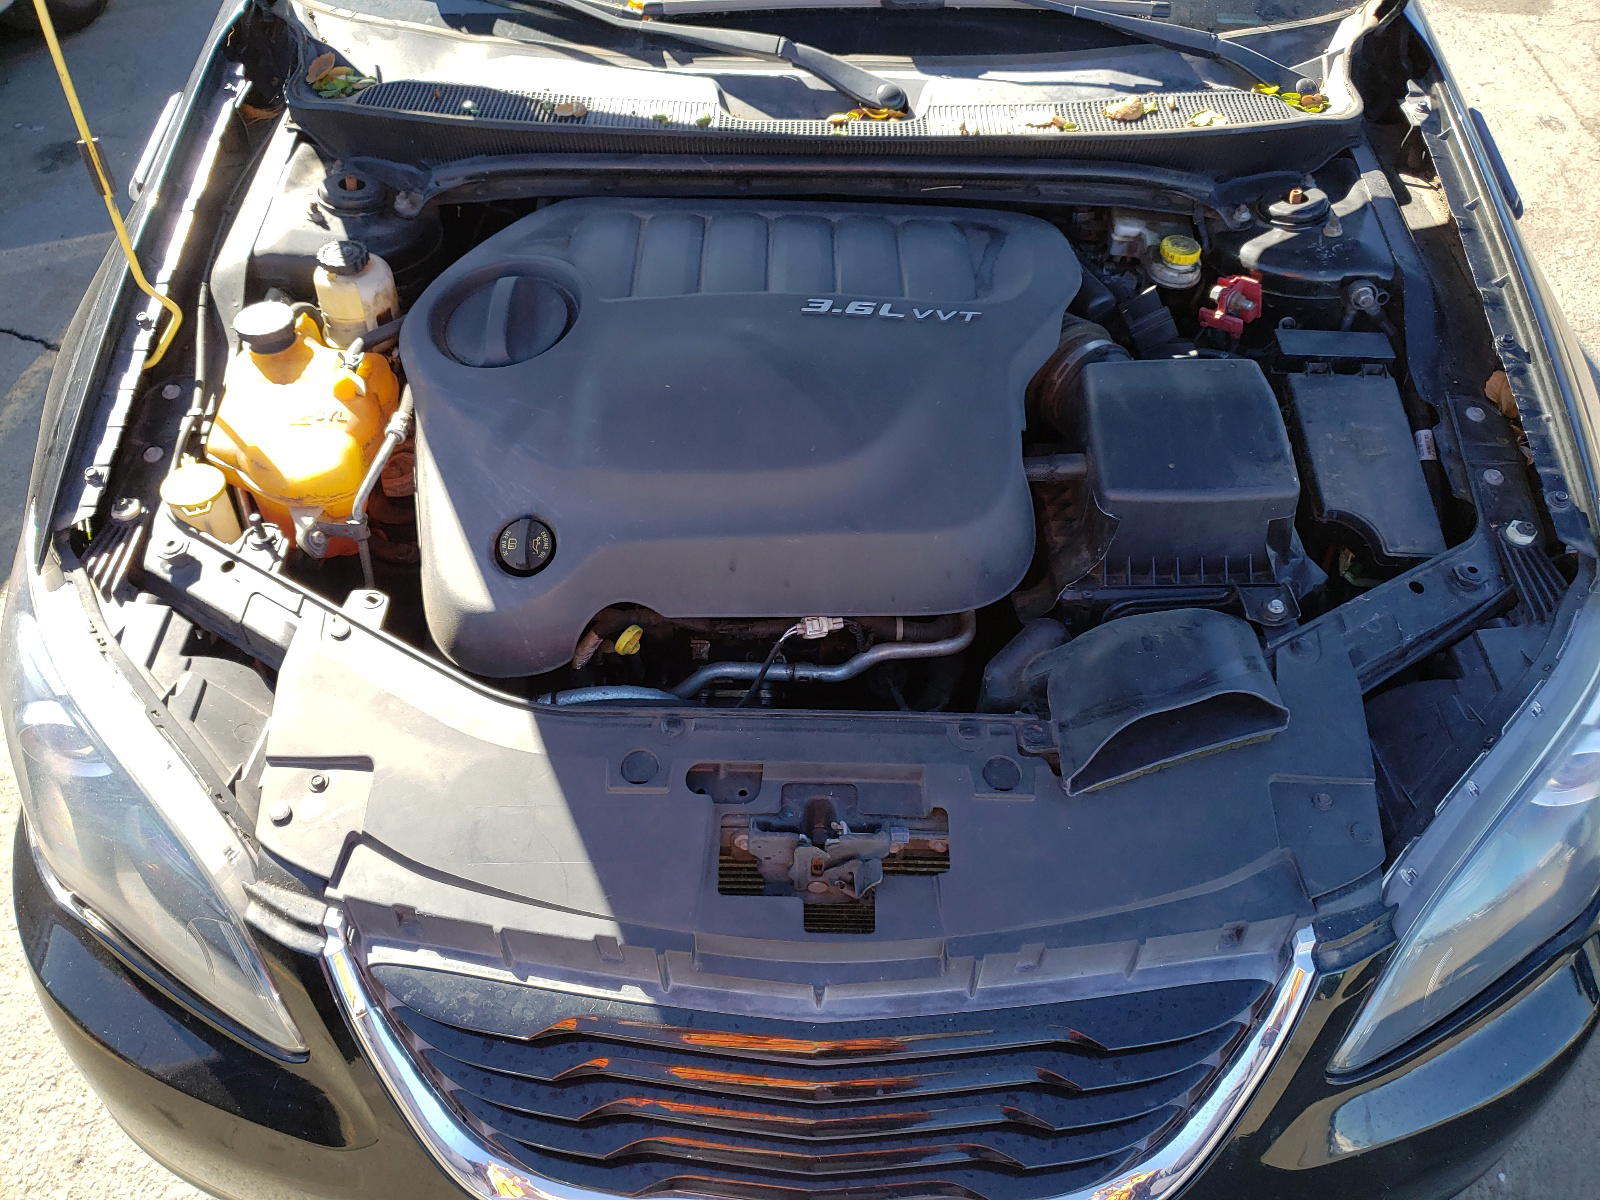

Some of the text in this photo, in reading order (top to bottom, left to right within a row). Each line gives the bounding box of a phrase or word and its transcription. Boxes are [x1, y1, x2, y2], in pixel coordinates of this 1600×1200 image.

[800, 298, 983, 323] 3.6L VVT
[541, 531, 549, 550] ENGINE
